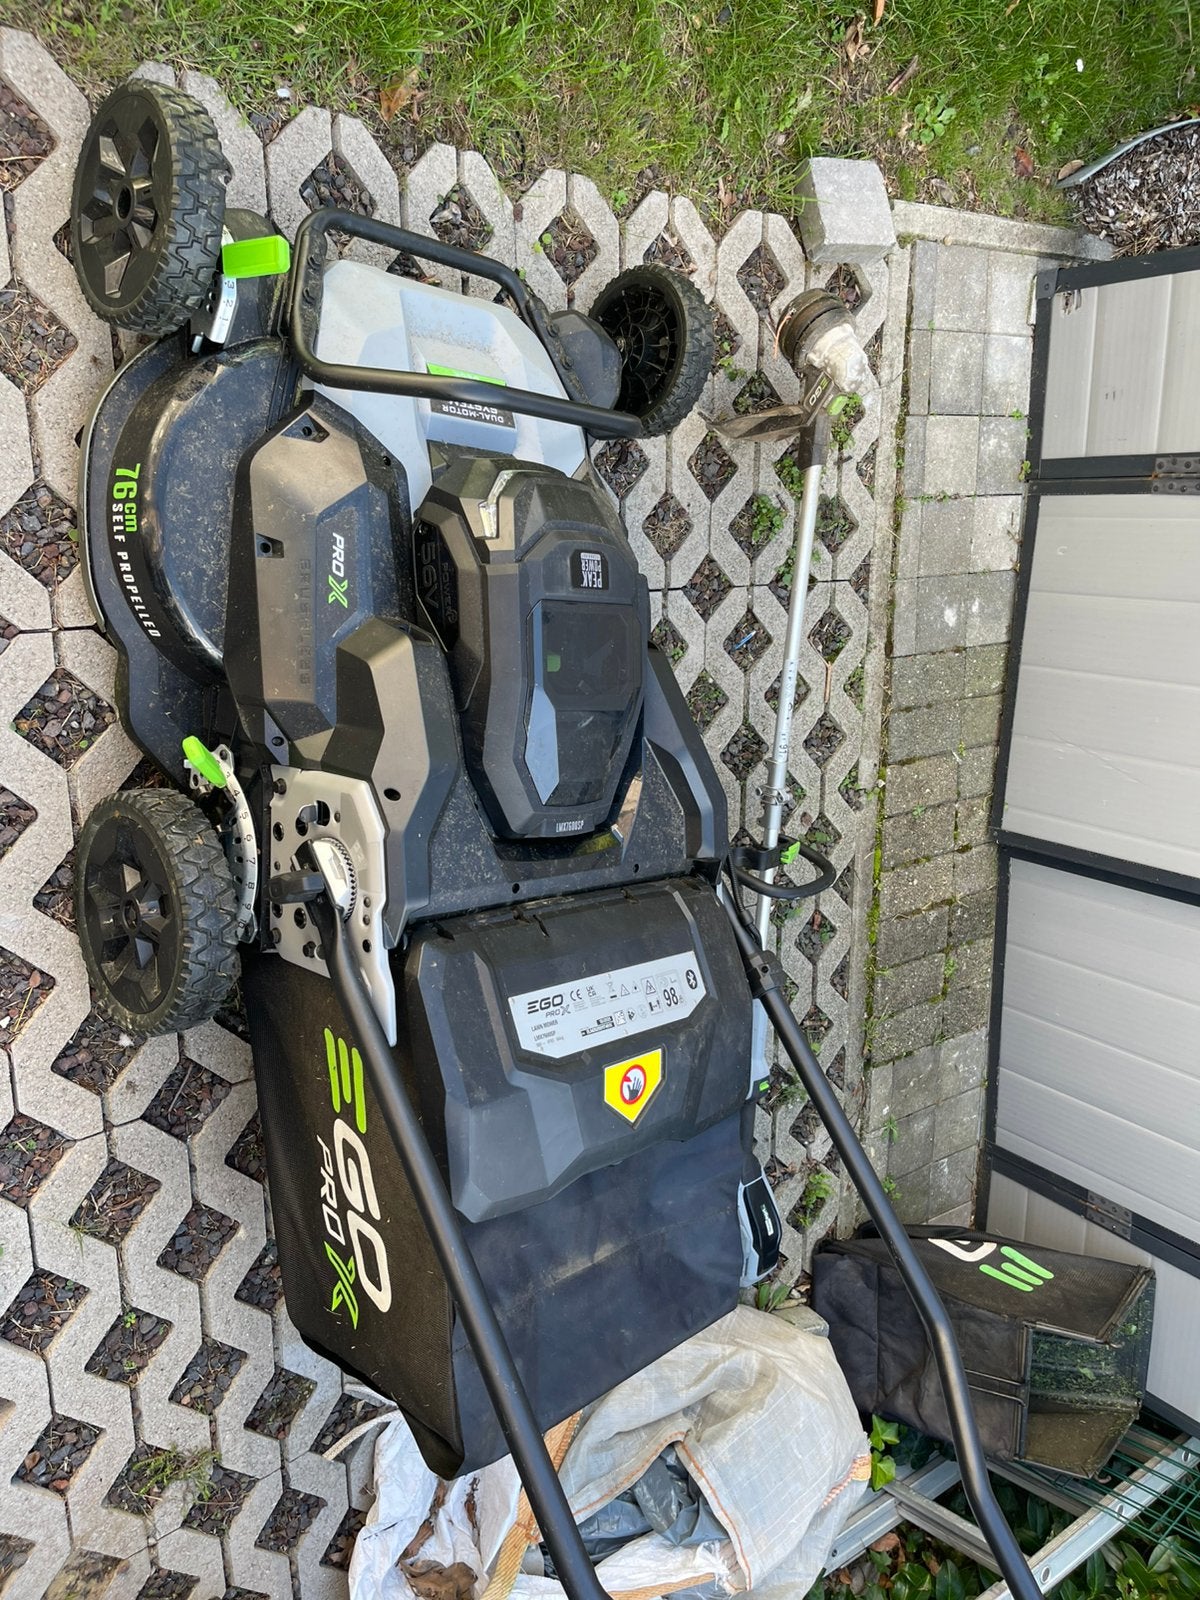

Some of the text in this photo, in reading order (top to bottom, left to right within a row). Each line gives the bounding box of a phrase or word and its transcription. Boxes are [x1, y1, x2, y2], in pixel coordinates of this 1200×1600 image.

[228, 280, 234, 289] 3
[226, 299, 233, 308] 2
[810, 377, 829, 406] EGO
[442, 404, 504, 423] DUAL-MOTOR
[112, 463, 141, 532] 76 cm
[112, 503, 162, 638] SELF PROPELLED
[422, 542, 438, 608] 56V
[582, 560, 602, 572] POWER
[582, 571, 602, 588] PEAK
[242, 812, 248, 820] 5
[246, 834, 253, 842] 6
[248, 857, 256, 865] 7
[248, 882, 255, 890] 8
[527, 994, 564, 1014] EGO
[662, 987, 679, 1007] 98
[324, 1028, 392, 1312] EGO
